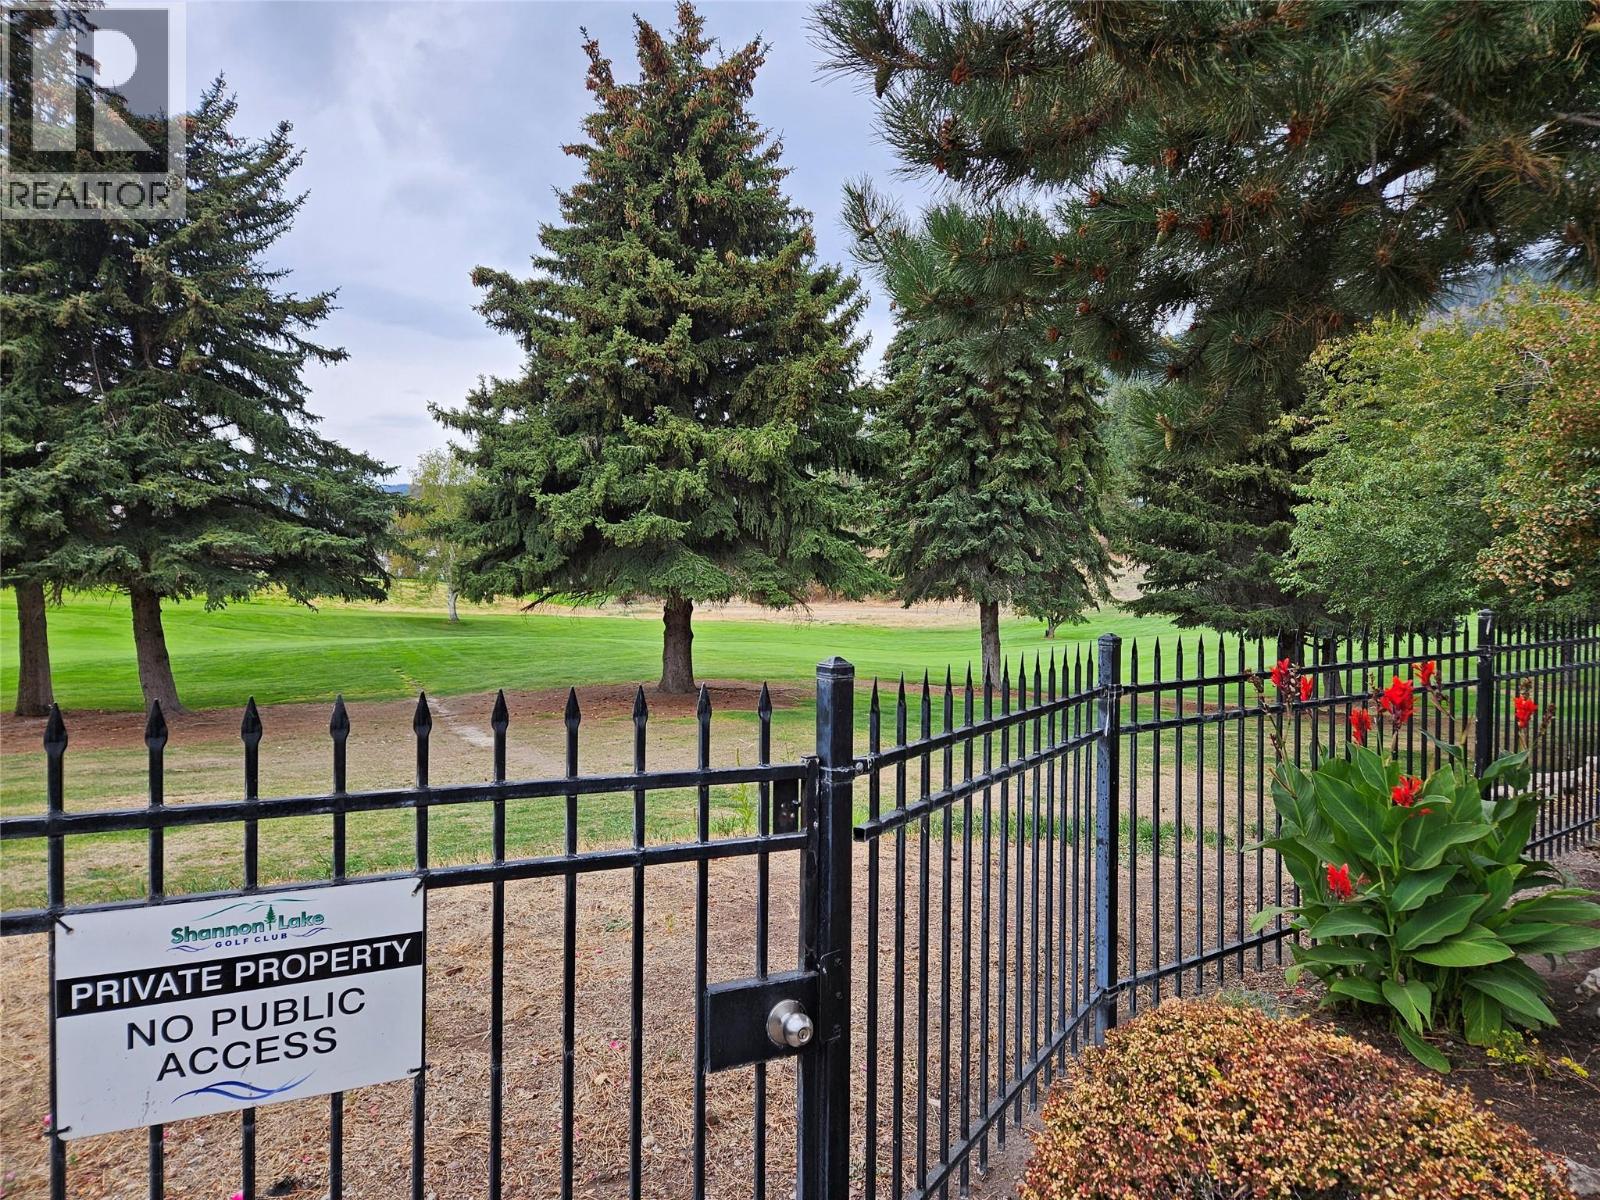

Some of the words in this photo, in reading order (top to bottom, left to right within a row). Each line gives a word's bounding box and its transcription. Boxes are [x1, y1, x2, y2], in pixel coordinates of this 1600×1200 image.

[170, 920, 265, 945] Shannon
[278, 910, 325, 930] Lake
[214, 937, 249, 949] GOLF
[254, 932, 288, 943] CLUB
[70, 965, 223, 1010] PRIVATE
[235, 938, 412, 987] PROPERTY
[127, 1014, 194, 1050] NO
[212, 987, 366, 1036] PUBLIC
[157, 1026, 338, 1082] ACCESS
